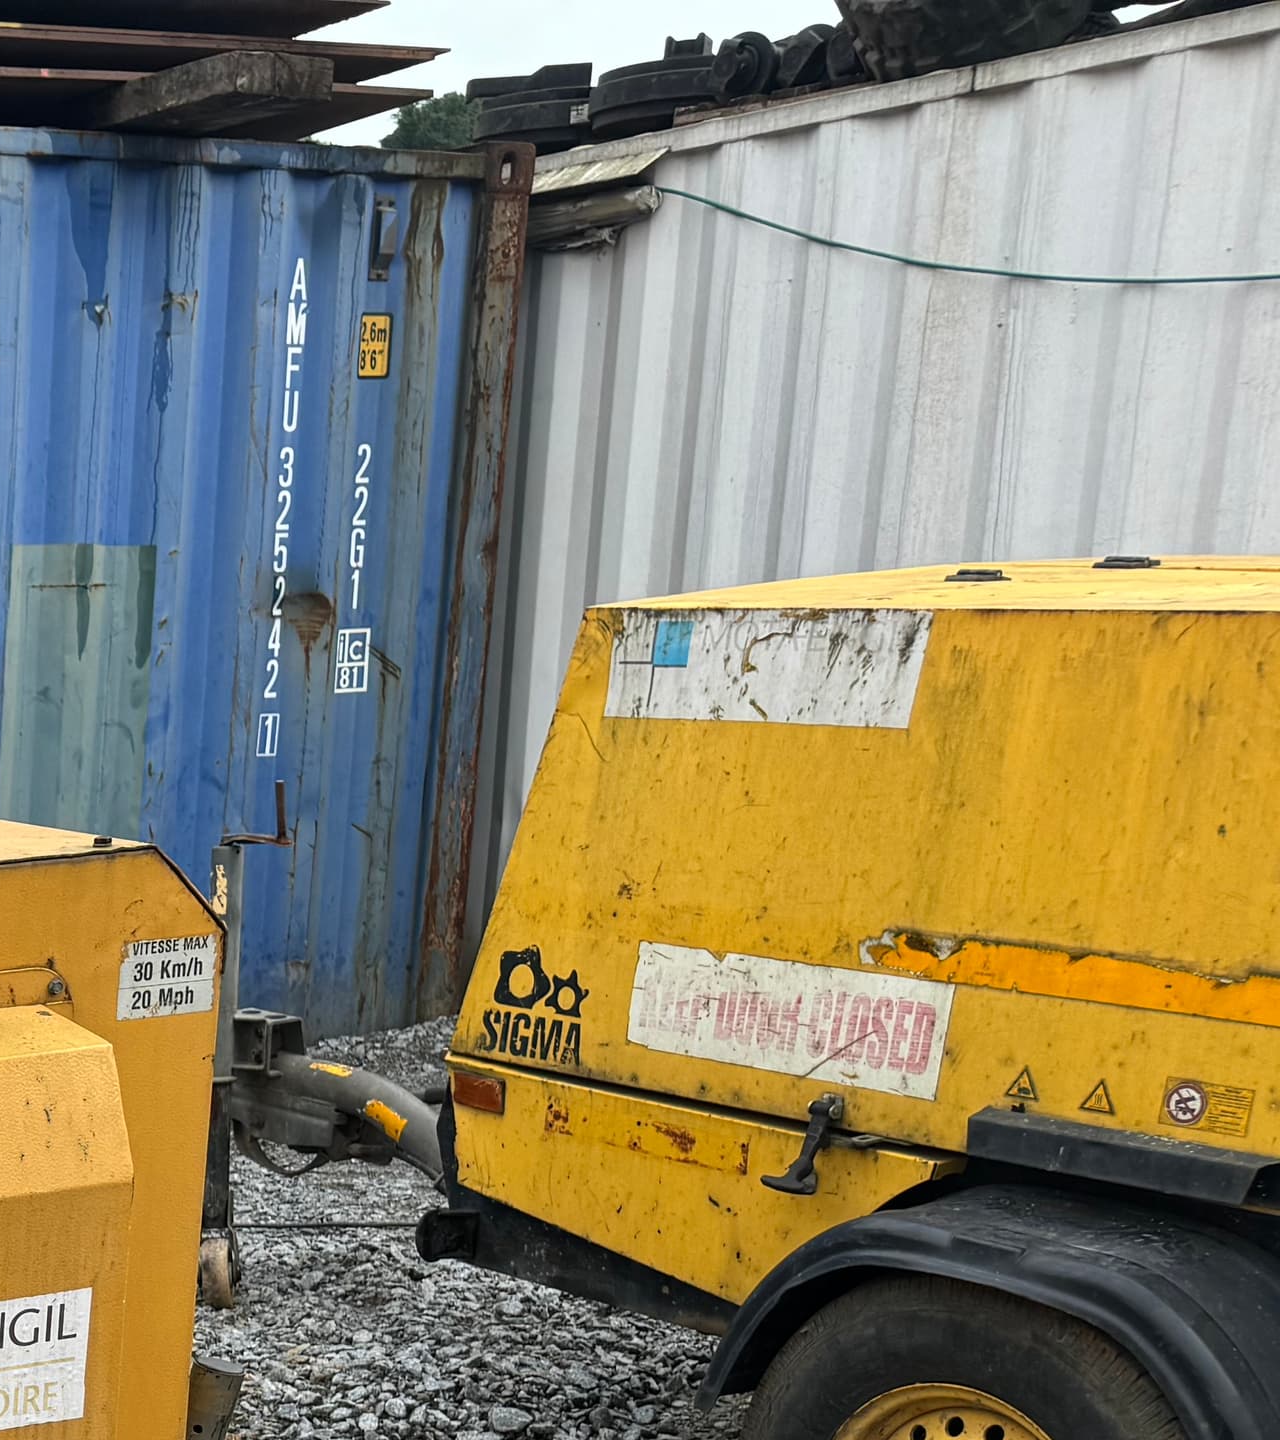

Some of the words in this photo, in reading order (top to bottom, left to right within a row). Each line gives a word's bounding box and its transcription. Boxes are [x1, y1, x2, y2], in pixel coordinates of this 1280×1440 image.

[282, 257, 308, 433] AMFU
[349, 443, 372, 610] 22G1
[340, 667, 360, 689] 81
[133, 938, 180, 956] VITESSE
[183, 935, 209, 951] MAX
[133, 962, 153, 982] 30
[160, 956, 203, 979] Km/h
[131, 990, 151, 1010] 20
[159, 986, 194, 1010] Mph
[482, 1008, 582, 1066] SIGMA
[806, 991, 937, 1076] CLOSED
